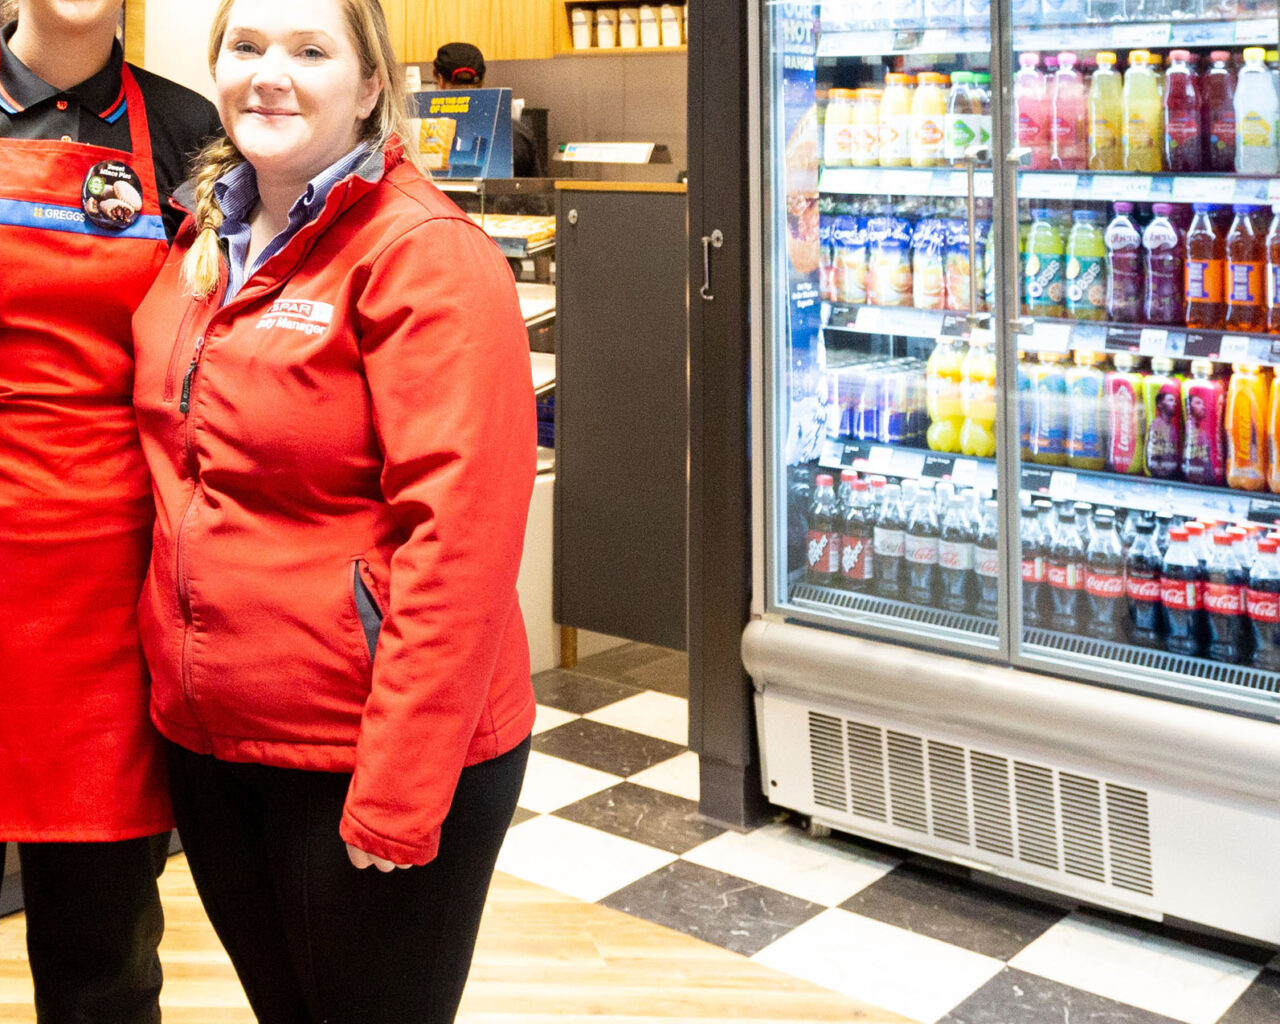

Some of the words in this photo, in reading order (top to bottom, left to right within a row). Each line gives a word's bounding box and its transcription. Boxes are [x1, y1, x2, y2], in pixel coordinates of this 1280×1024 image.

[782, 18, 814, 44] HOT
[44, 208, 86, 223] GREGGS
[271, 302, 312, 317] SPAR
[275, 316, 327, 335] Manager
